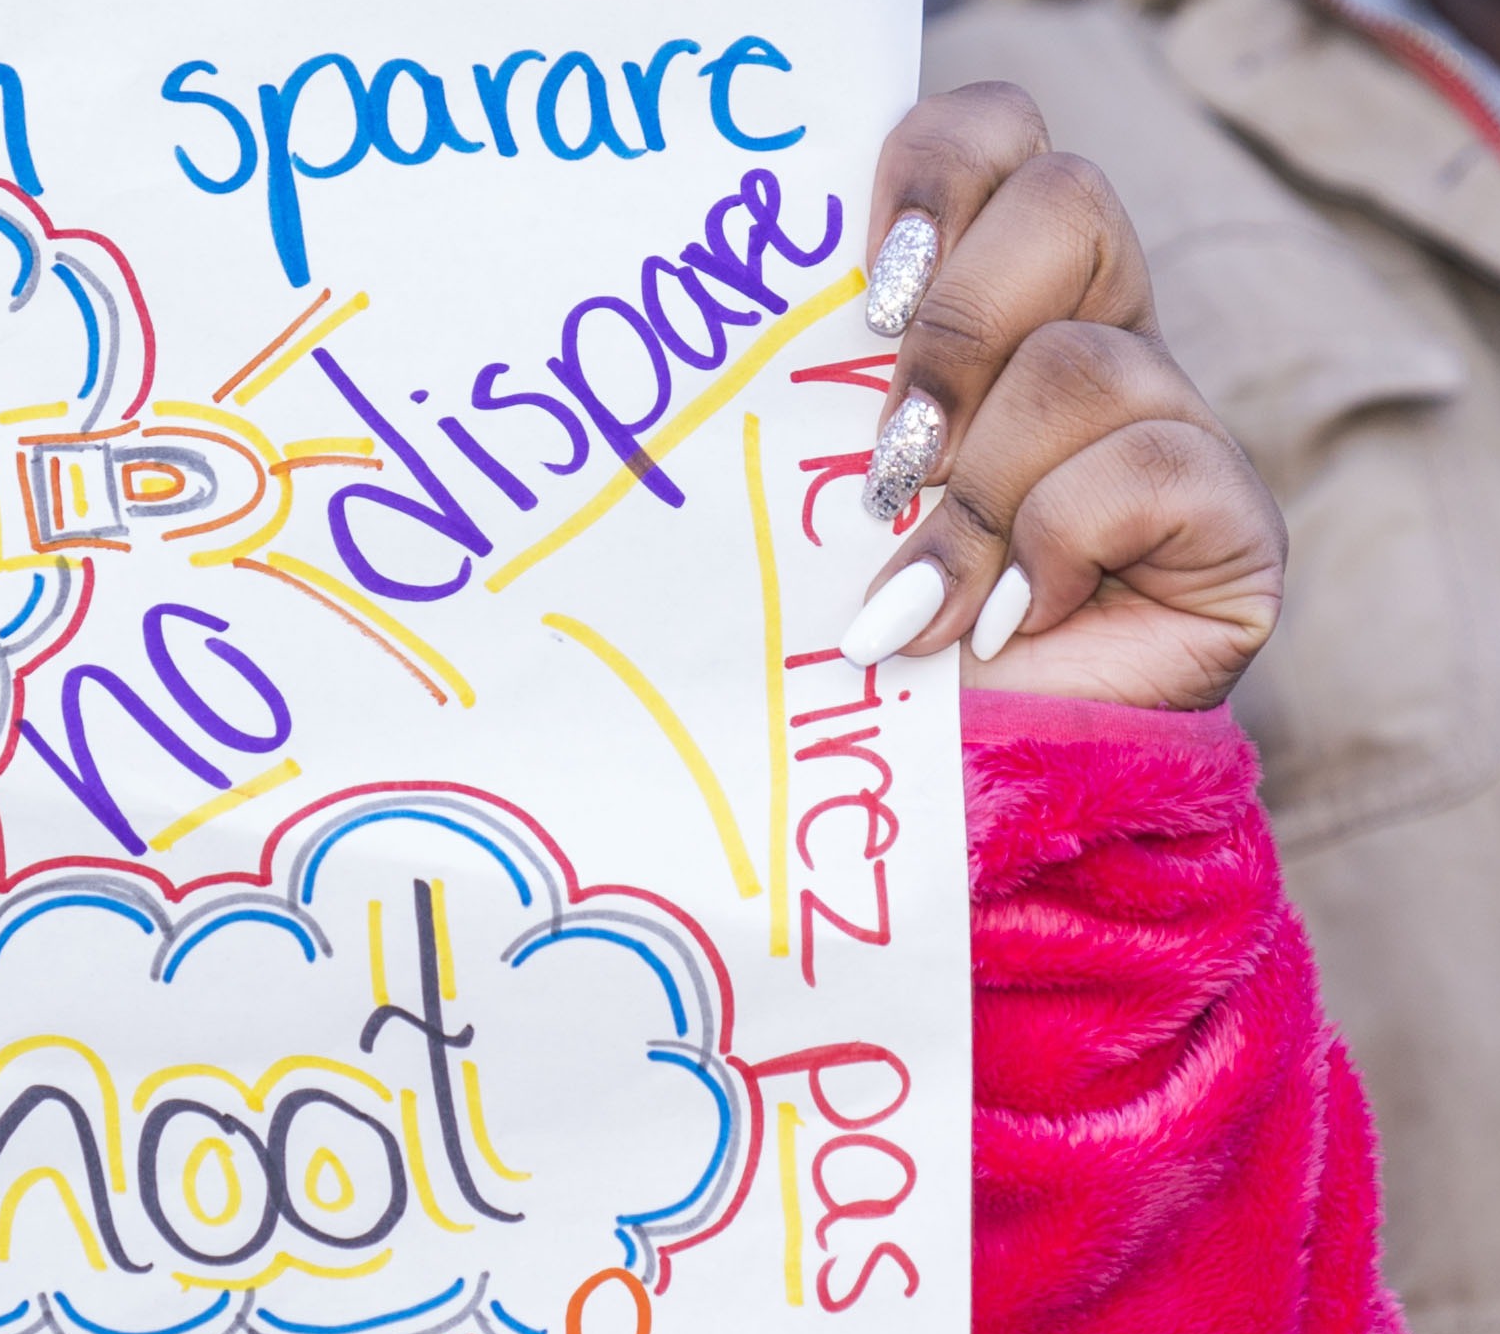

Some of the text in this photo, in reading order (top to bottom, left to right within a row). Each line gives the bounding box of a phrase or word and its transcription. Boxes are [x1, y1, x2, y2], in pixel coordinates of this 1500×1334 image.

[160, 34, 808, 289] sparare
[18, 167, 844, 858] no dispare
[725, 1041, 921, 1314] pas
